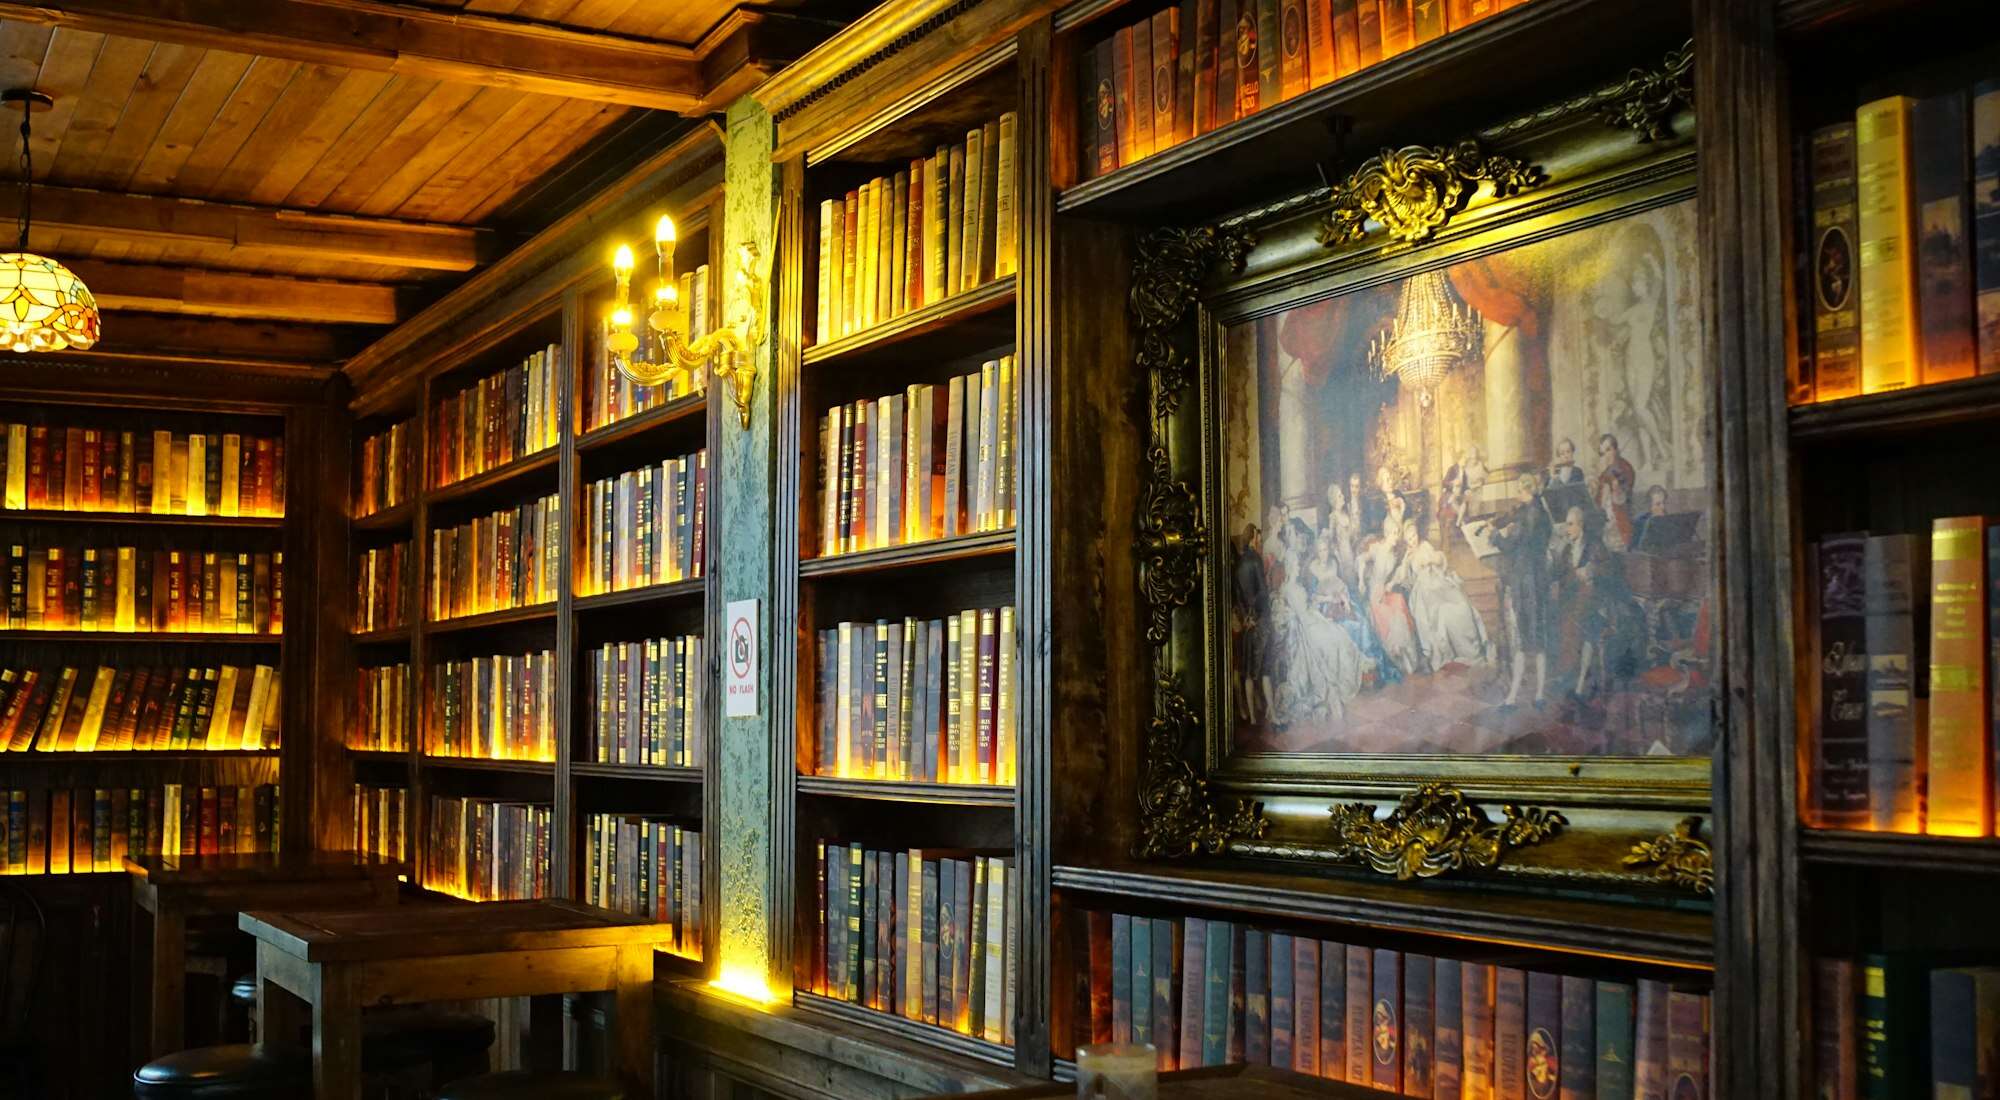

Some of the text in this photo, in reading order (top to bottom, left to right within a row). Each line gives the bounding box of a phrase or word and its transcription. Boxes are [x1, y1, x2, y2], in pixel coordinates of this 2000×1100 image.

[729, 684, 753, 694] NO FLASH
[1351, 1063, 1365, 1083] ART
